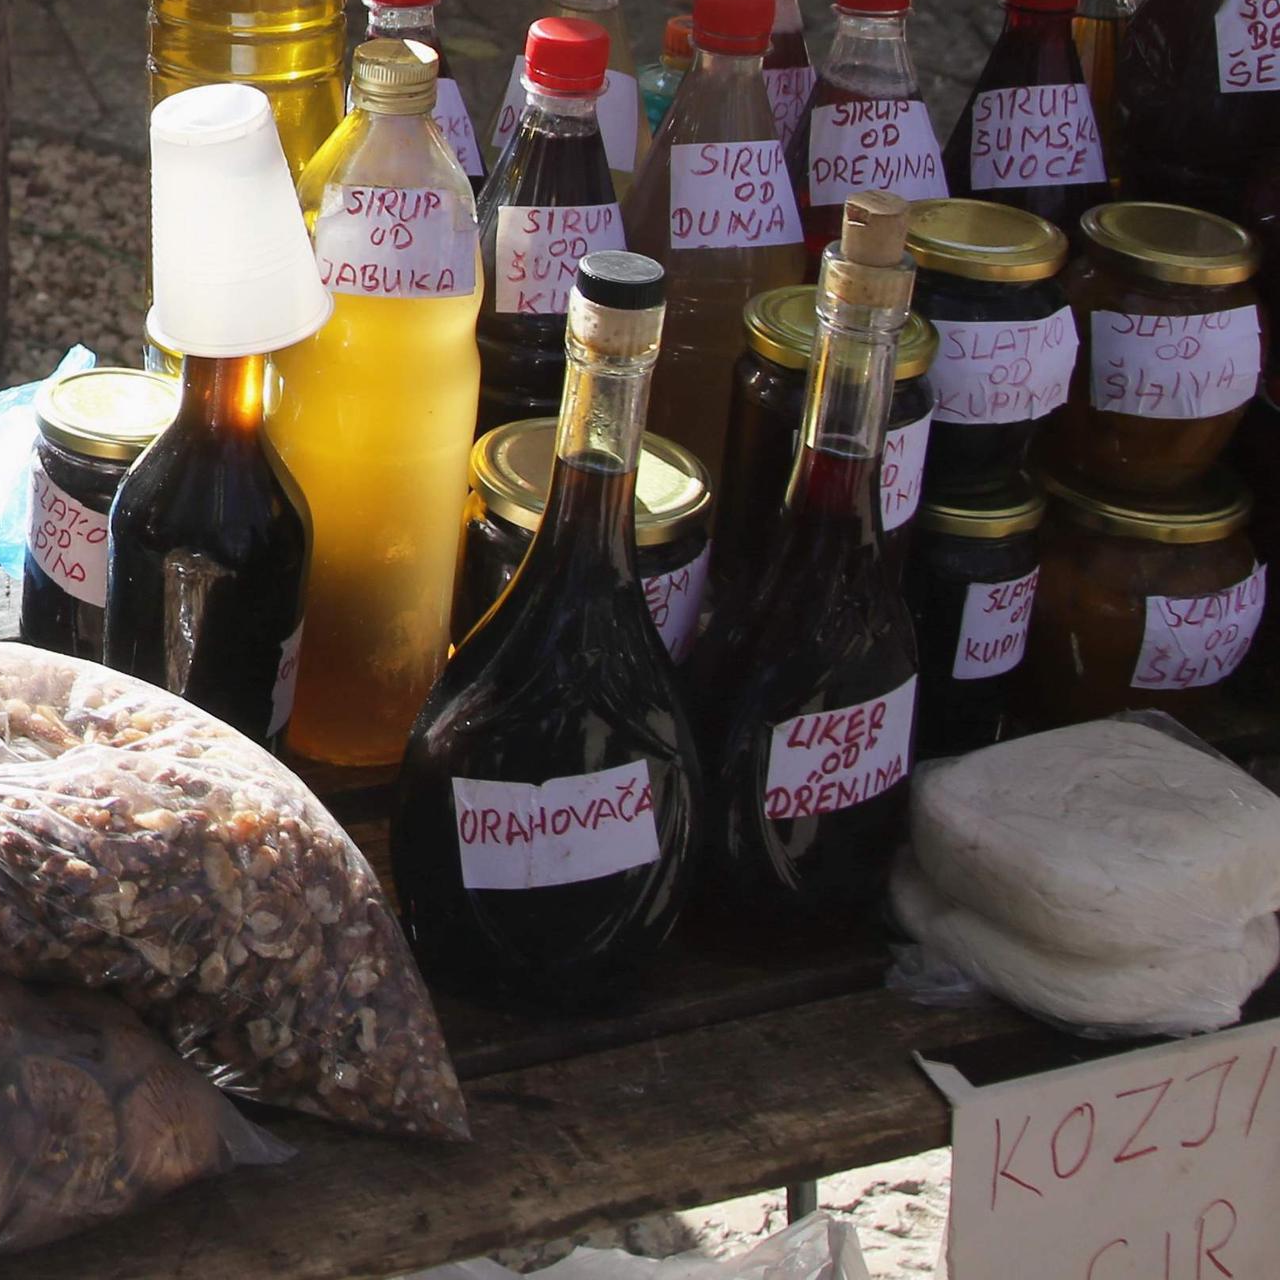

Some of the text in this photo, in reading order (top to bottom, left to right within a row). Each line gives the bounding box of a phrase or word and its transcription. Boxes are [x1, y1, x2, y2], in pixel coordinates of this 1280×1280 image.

[832, 100, 909, 126] SIRUP
[976, 84, 1078, 122] SIRUP
[860, 123, 900, 148] OD
[347, 188, 440, 222] SIRUP
[734, 181, 774, 204] OD
[522, 207, 612, 235] SIRUP
[548, 237, 588, 259] OD
[320, 258, 455, 292] JABUKA
[1155, 336, 1200, 360] OD
[989, 358, 1031, 385] OD
[44, 520, 71, 548] OD
[1205, 624, 1239, 650] OD
[991, 1046, 1277, 1211] KOZJI
